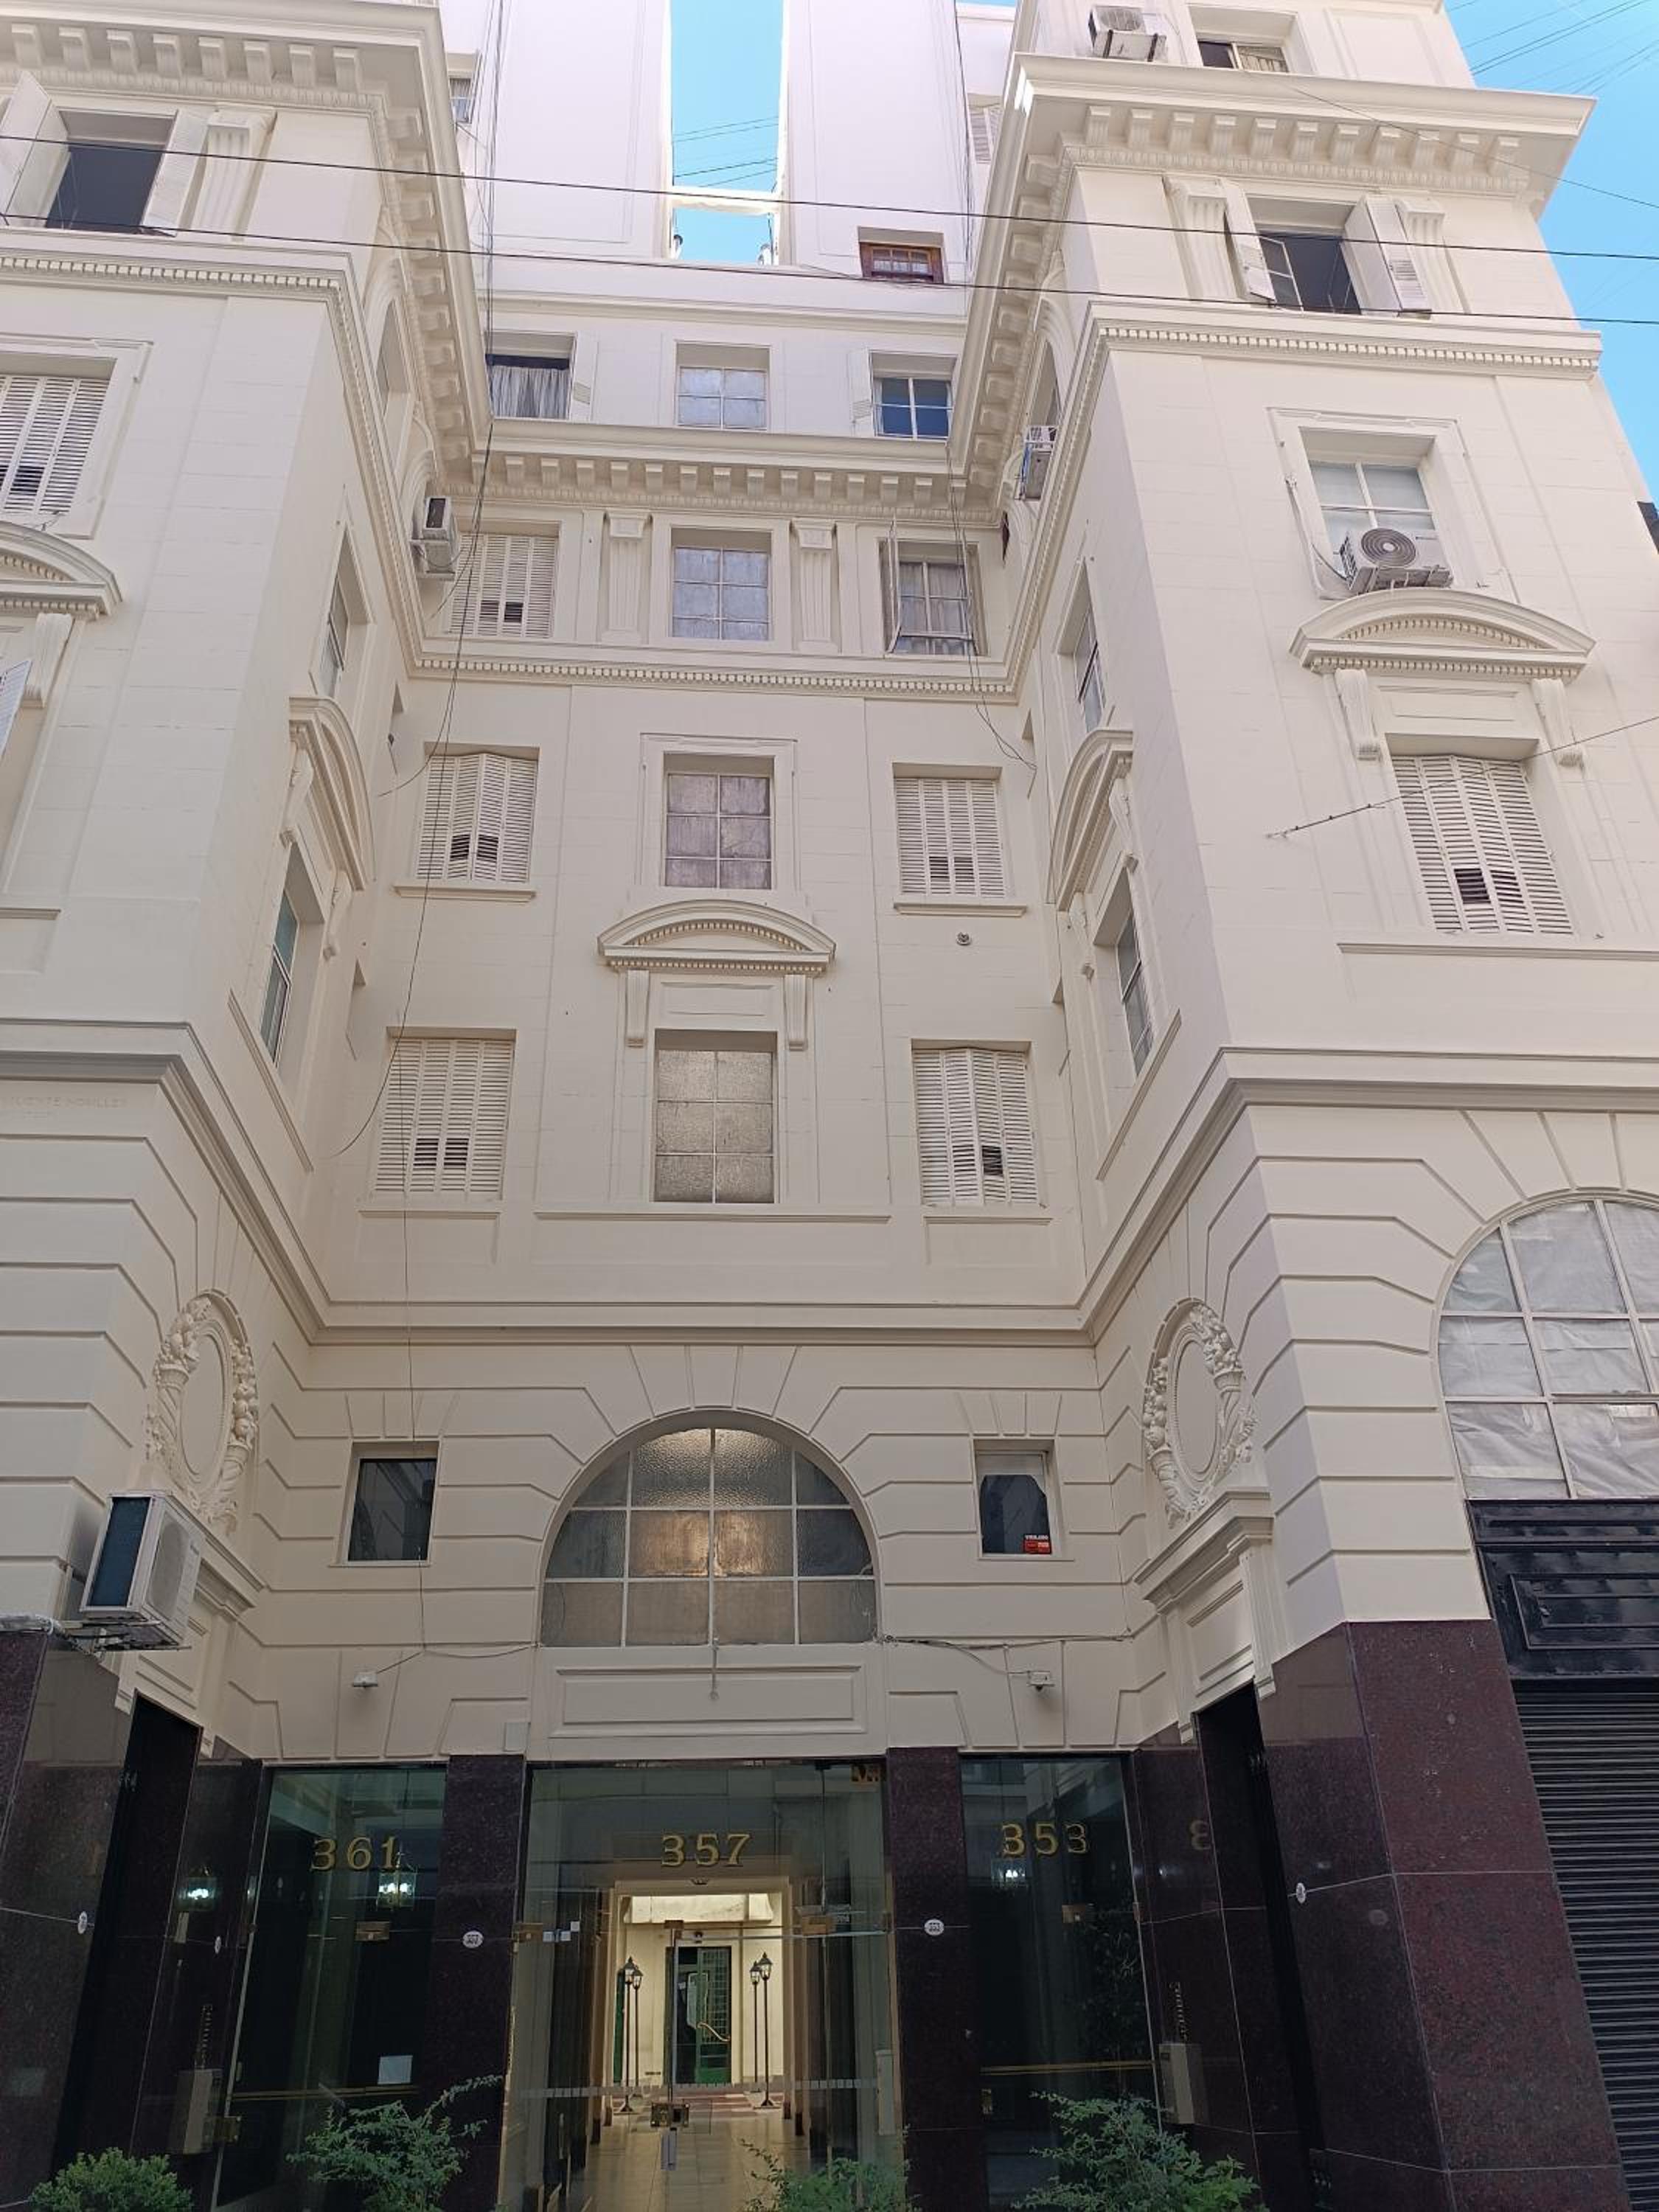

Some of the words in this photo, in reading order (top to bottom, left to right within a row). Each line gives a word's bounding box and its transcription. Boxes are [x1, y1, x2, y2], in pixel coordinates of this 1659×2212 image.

[310, 1837, 397, 1871] 361
[661, 1834, 750, 1866] 357
[1002, 1823, 1087, 1855] 353
